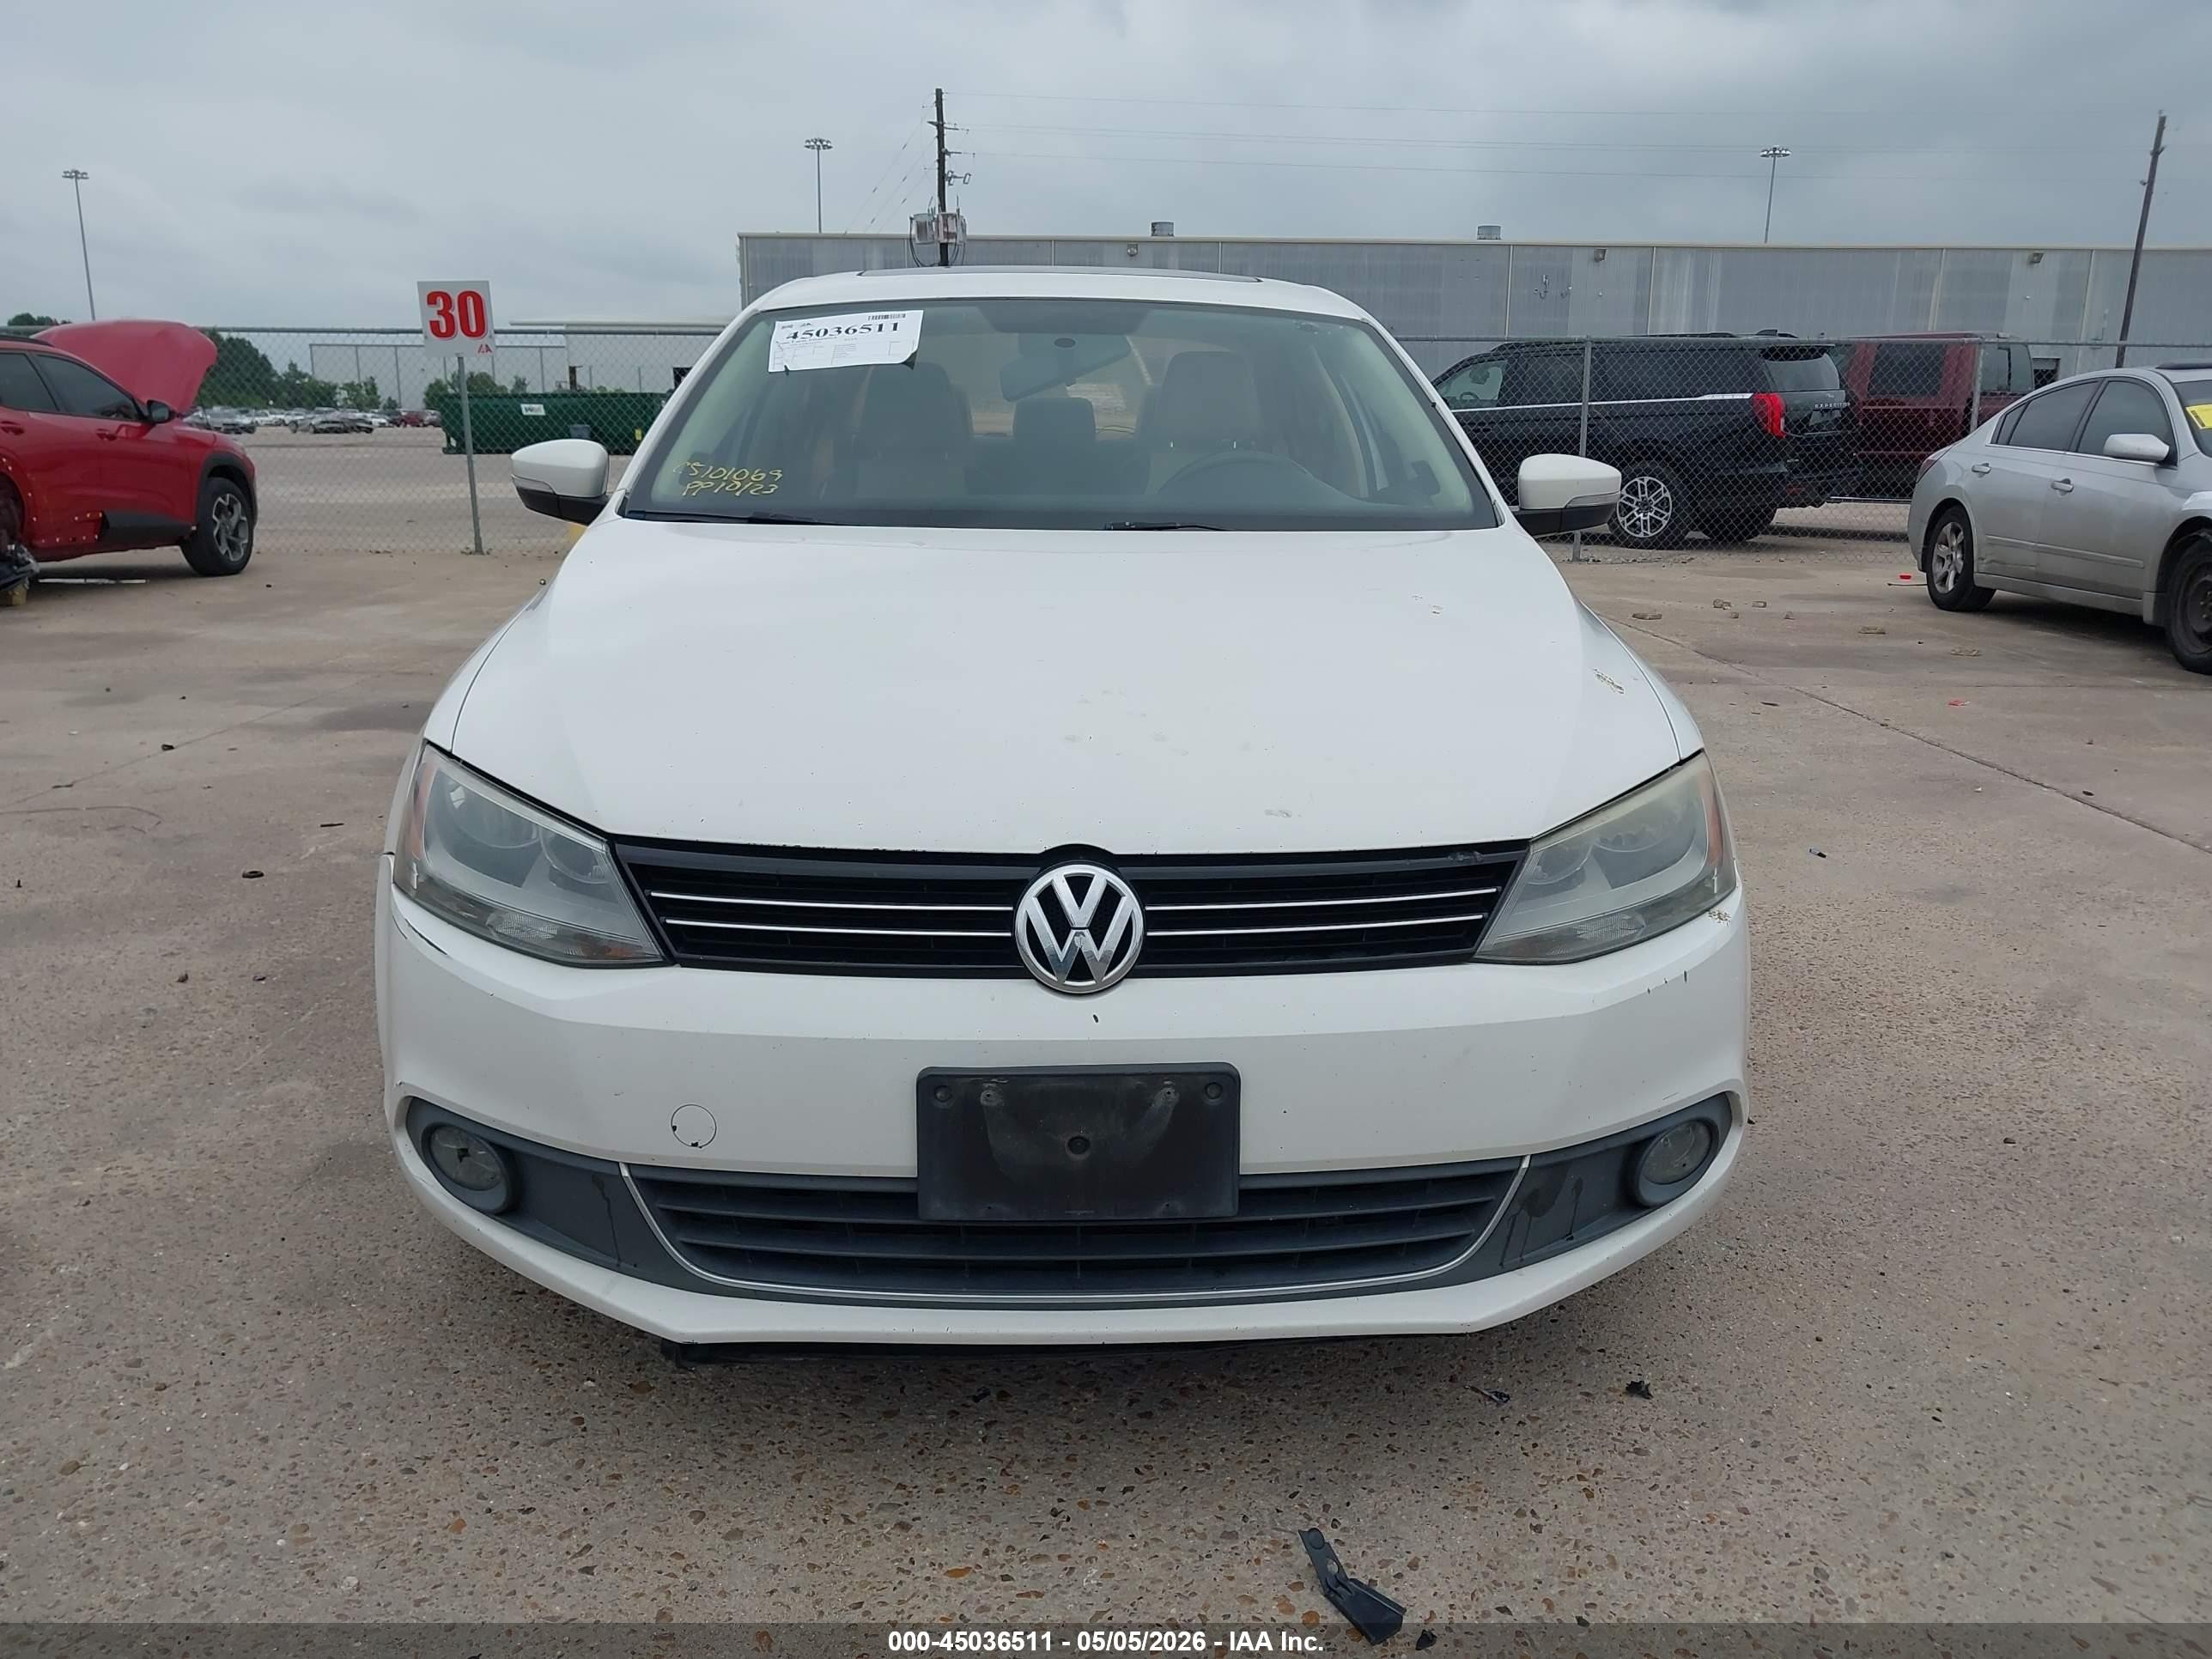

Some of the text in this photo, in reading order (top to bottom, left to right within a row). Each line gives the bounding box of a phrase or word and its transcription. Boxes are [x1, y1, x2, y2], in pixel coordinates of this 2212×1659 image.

[426, 290, 486, 339] 30
[786, 321, 900, 341] 45036511
[1016, 865, 1143, 994] VW
